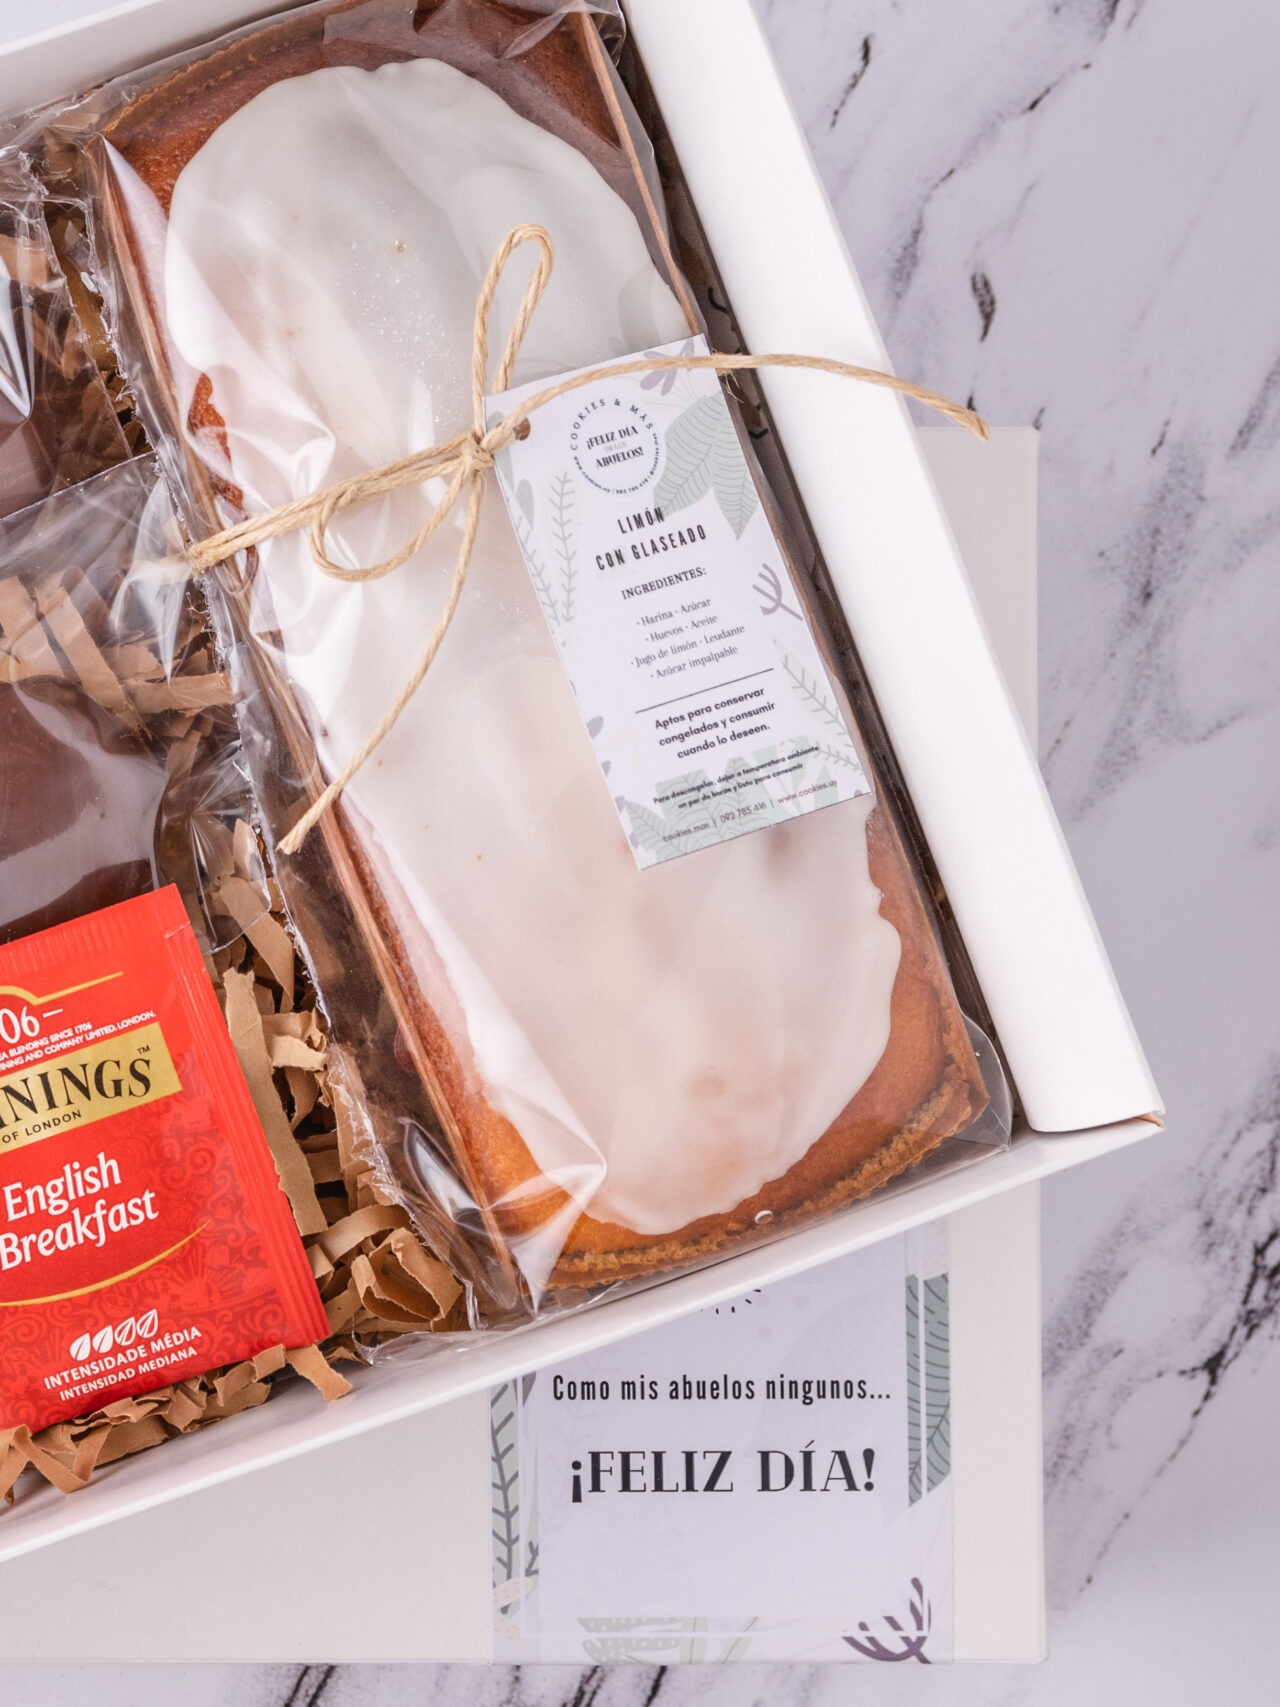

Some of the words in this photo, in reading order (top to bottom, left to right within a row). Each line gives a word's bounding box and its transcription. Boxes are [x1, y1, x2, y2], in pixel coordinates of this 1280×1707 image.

[570, 398, 606, 451] COOKIES
[586, 431, 616, 450] ¡FELIZ
[618, 425, 638, 439] DÍA
[596, 446, 644, 468] ABUELOS!
[617, 506, 665, 534] LIMÓN
[595, 549, 625, 571] CON
[631, 524, 706, 560] GLASEADO
[621, 566, 707, 600] INGREDIENTES:
[641, 610, 674, 626] Harina
[680, 599, 711, 614] Azúcar
[650, 626, 684, 642] Huevos
[691, 615, 718, 630] Aceite
[635, 654, 656, 668] Jugo
[658, 649, 669, 659] de
[670, 640, 698, 655] limón
[704, 625, 746, 644] Leudante
[656, 663, 687, 679] Azúcar
[689, 645, 738, 668] impalpable
[655, 715, 686, 730] Aptos
[687, 706, 712, 722] para
[714, 688, 765, 710] conservar
[659, 722, 719, 746] congelados
[721, 719, 727, 728] y
[729, 702, 775, 723] consumir
[677, 739, 716, 758] cuando
[716, 736, 728, 745] lo
[729, 723, 771, 741] deseen.
[777, 779, 838, 804] www.cookies.uy
[9, 1036, 49, 1058] BLENDING
[49, 1028, 74, 1043] SINCE
[74, 1022, 93, 1034] 1706
[25, 1049, 44, 1062] AND
[44, 1035, 84, 1055] COMPANY
[117, 1010, 157, 1030] LONDON.
[1, 1131, 20, 1144] OF
[25, 1109, 82, 1137] LONDON
[2, 1151, 122, 1222] English
[43, 1345, 147, 1390] INTENSIDADE
[150, 1326, 202, 1354] MÉDIA
[59, 1368, 136, 1402] INTENSIDAD
[138, 1346, 198, 1375] MEDIANA
[552, 1374, 610, 1401] Como
[620, 1374, 658, 1401] mis
[669, 1374, 756, 1400] abuelos
[765, 1373, 892, 1406] ningunos...
[571, 1450, 734, 1503] ¡FELIZ
[756, 1439, 876, 1493] DÍA!
